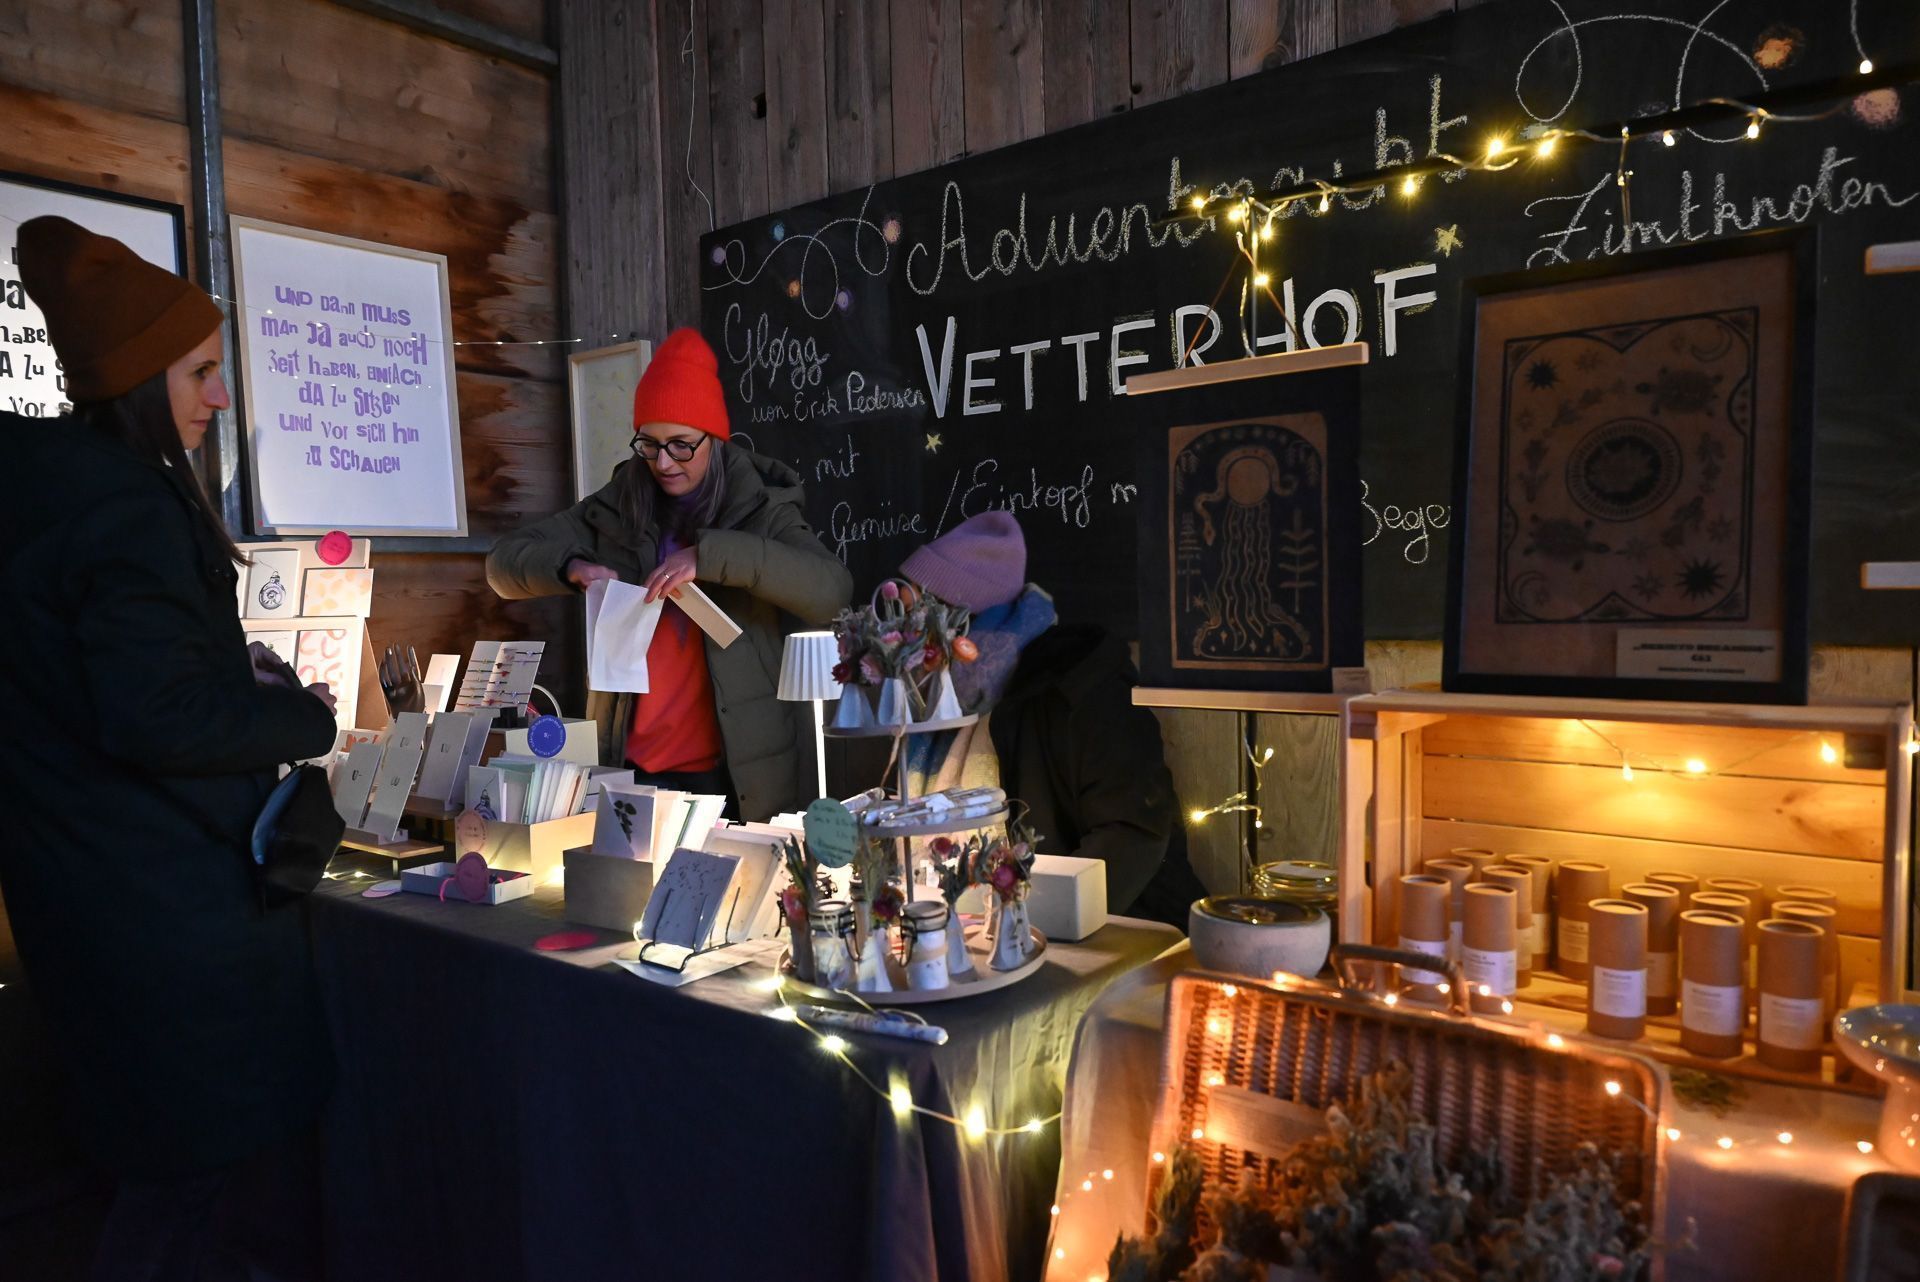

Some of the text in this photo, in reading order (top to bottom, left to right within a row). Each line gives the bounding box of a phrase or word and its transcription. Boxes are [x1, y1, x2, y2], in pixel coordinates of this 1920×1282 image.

[916, 263, 1438, 419] VETTERHOF
[795, 386, 840, 422] Erik
[816, 434, 861, 482] mit
